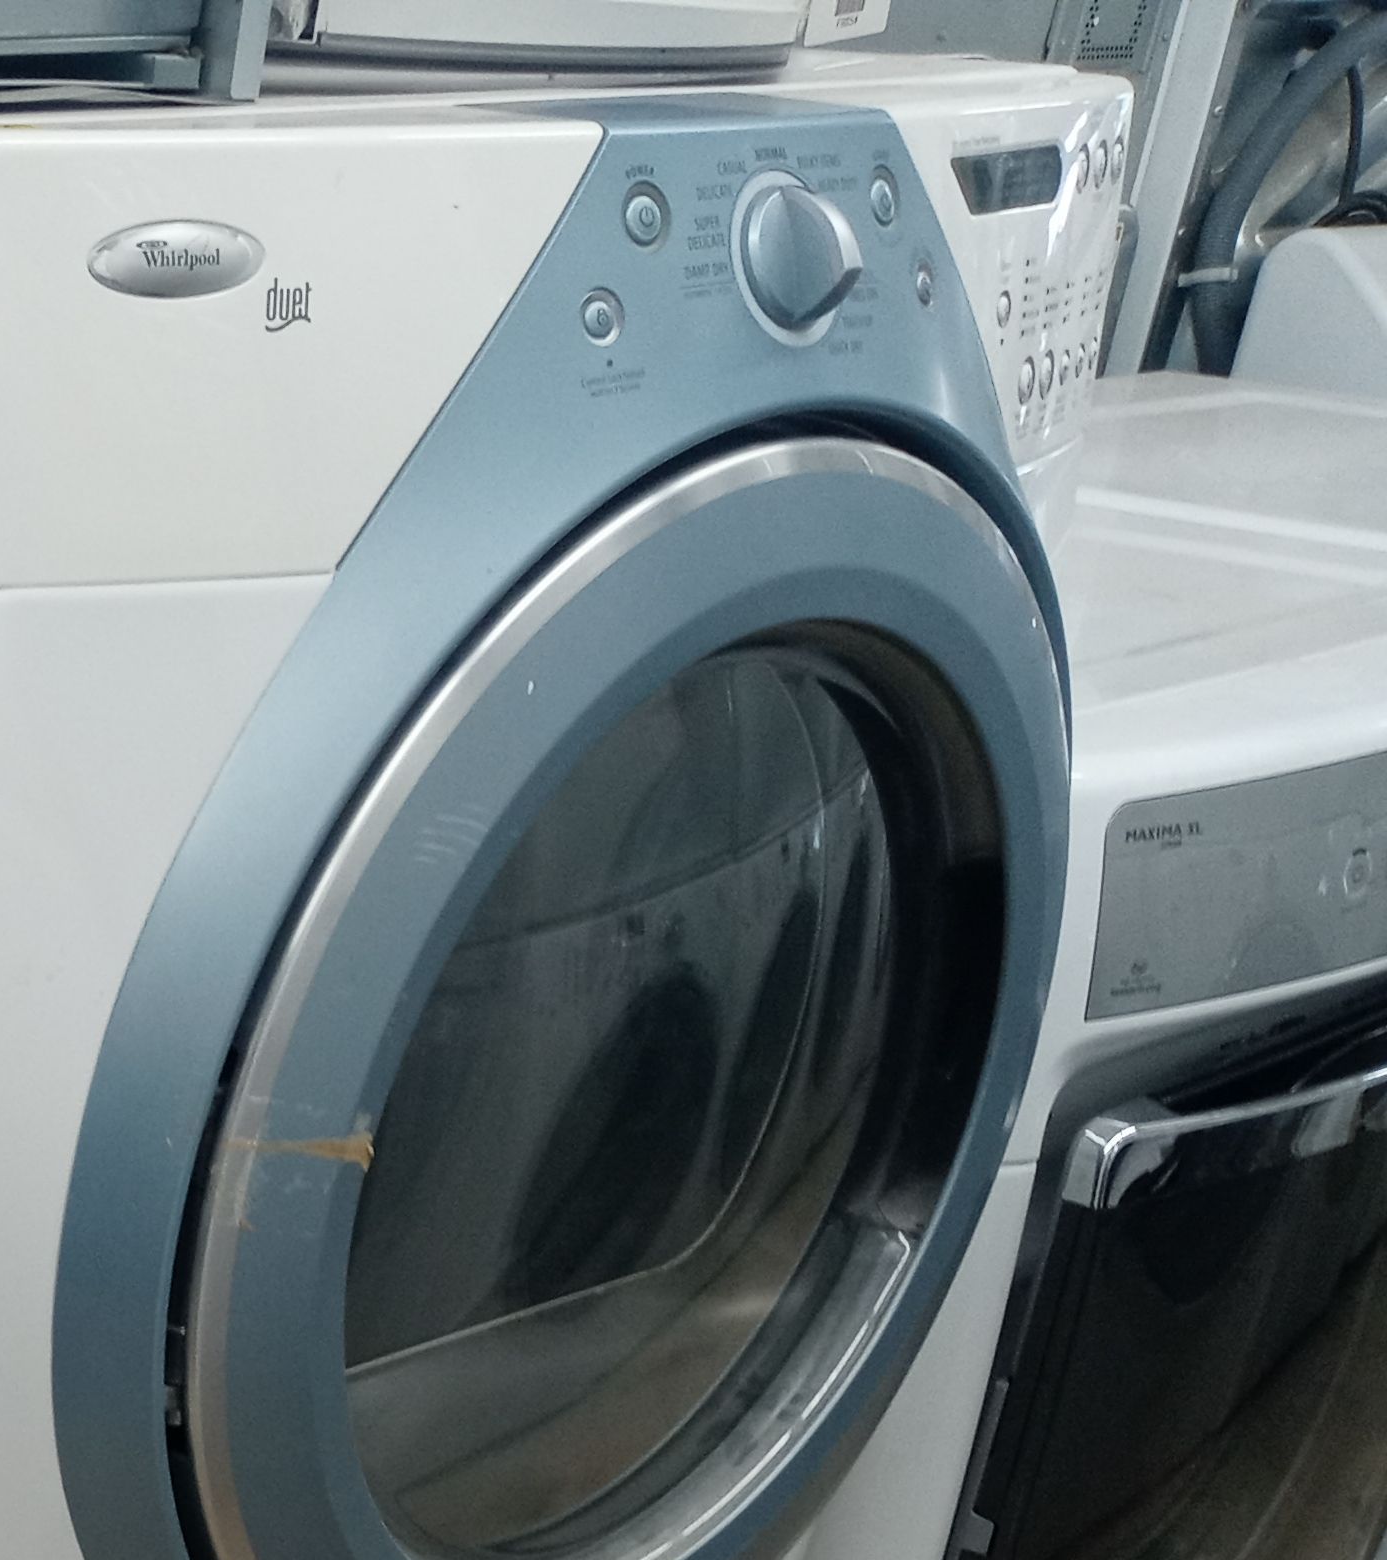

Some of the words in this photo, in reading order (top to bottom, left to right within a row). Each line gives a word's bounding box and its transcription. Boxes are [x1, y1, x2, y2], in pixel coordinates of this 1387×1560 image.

[142, 248, 221, 271] Whirlpool
[265, 277, 312, 333] duet
[1124, 822, 1183, 843] MAXIMA
